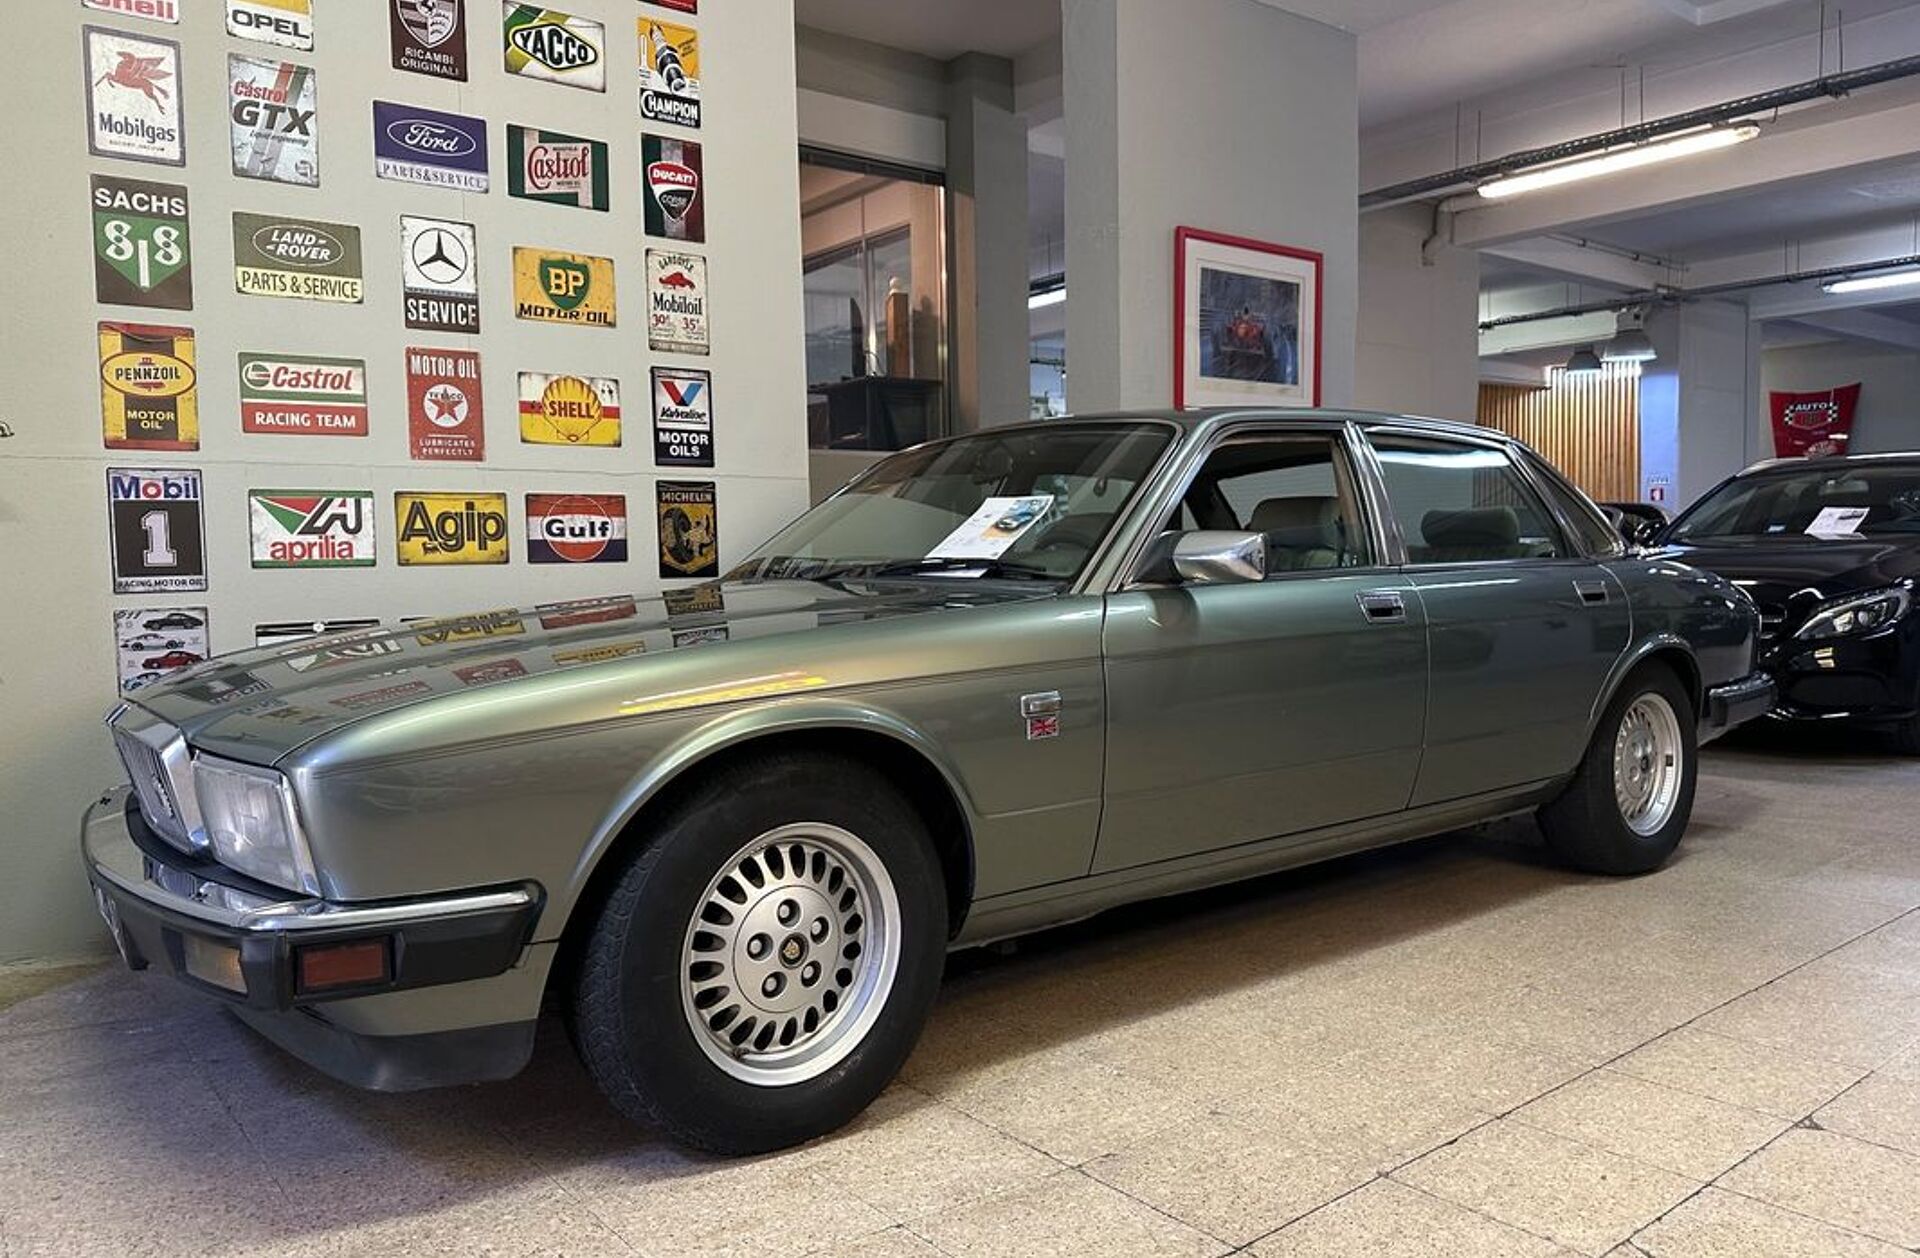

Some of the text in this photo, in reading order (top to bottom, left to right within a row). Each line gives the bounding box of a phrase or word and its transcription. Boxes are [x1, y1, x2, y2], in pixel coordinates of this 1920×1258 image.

[231, 9, 311, 39] OPEL
[404, 47, 454, 64] RICAMBI
[518, 26, 588, 66] YACCO
[400, 57, 459, 75] ORIGINALI
[233, 79, 288, 103] Castrol
[640, 90, 698, 120] CHAMPION
[99, 112, 176, 144] Mobilgas
[232, 99, 315, 136] GTX
[404, 125, 459, 152] Ford
[528, 145, 590, 191] Castrol
[652, 168, 692, 184] DUCATI
[94, 187, 186, 216] SACHS
[242, 271, 359, 299] PARTS & SERVICE
[548, 267, 585, 297] BP
[406, 299, 477, 326] SERVICE
[519, 303, 612, 325] MOTOR OIL
[653, 291, 703, 315] Mobiloil
[115, 368, 181, 381] PENNZOIL
[411, 355, 477, 378] MOTOR OIL
[272, 366, 353, 391] Castrol
[127, 411, 175, 422] MOTOR
[549, 399, 595, 420] SHELL
[659, 406, 707, 420] Valvoline
[1795, 402, 1827, 411] AUTO
[140, 419, 163, 430] OIL
[255, 411, 356, 428] RACING TEAM
[419, 439, 475, 448] LUBRICATES
[659, 431, 709, 446] MOTOR
[422, 448, 473, 457] PERFECTLY
[669, 445, 700, 457] OILS
[112, 476, 199, 499] Mobil
[661, 492, 713, 502] MICHELIN
[401, 501, 505, 552] Agip
[545, 518, 611, 539] Gulf
[141, 510, 177, 567] 1
[269, 535, 354, 566] aprilia
[116, 579, 152, 588] RACING
[155, 579, 187, 587] MOTOR
